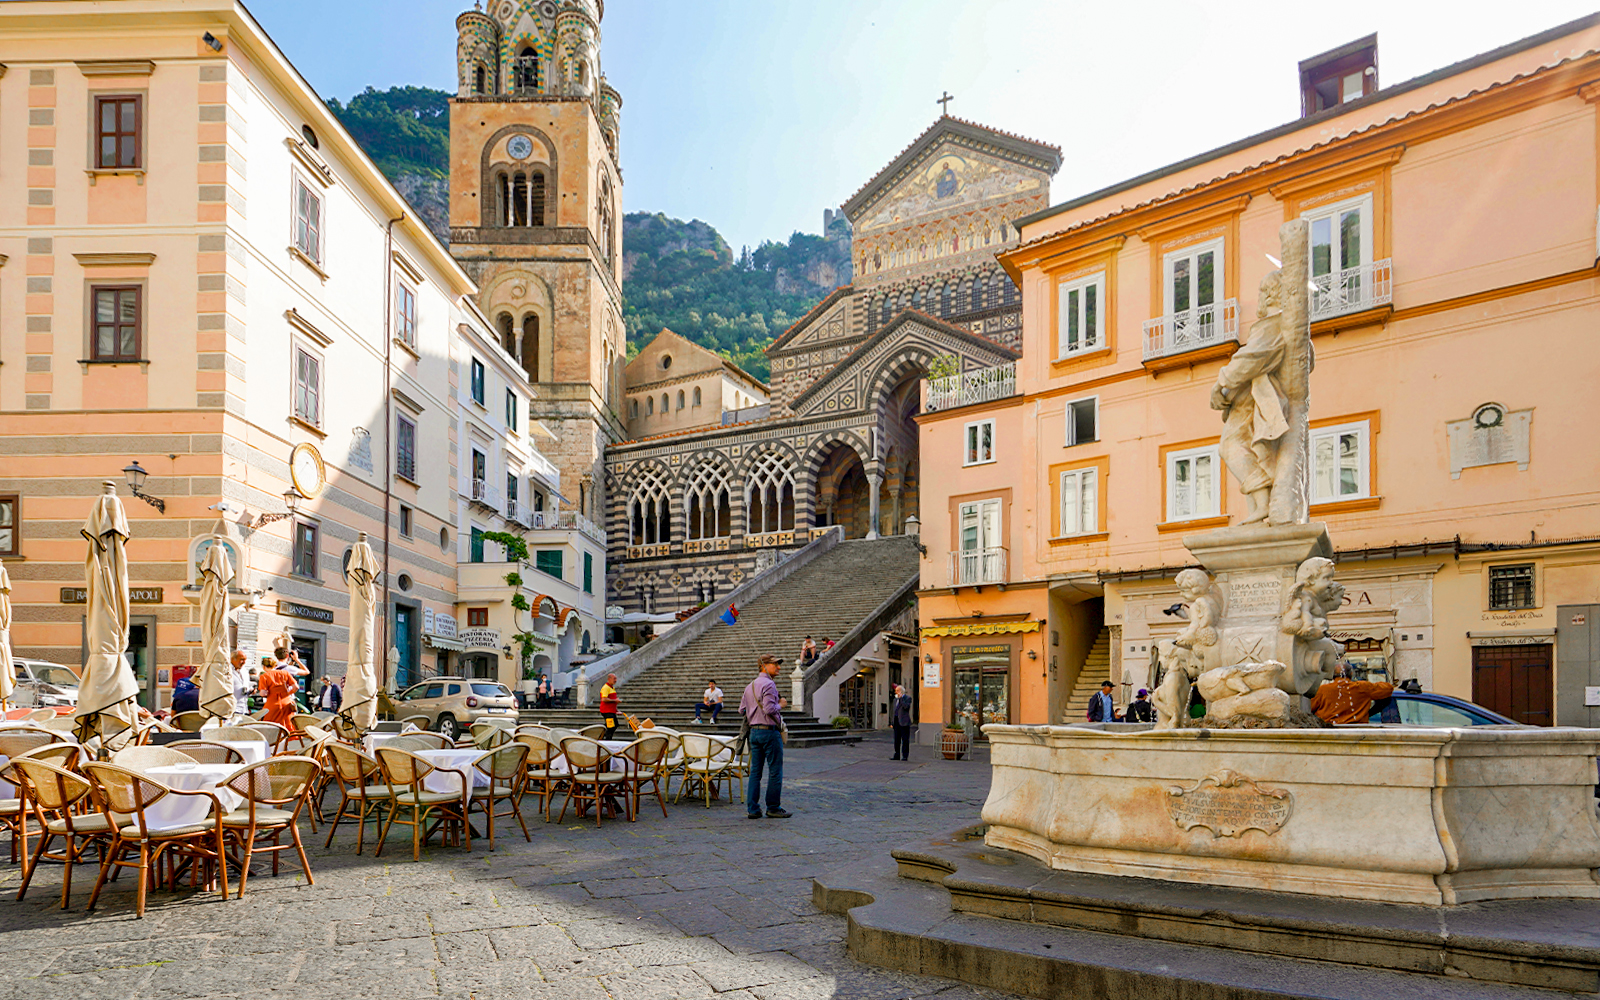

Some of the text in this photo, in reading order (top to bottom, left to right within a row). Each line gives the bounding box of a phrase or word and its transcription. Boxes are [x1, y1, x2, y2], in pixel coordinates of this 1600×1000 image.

[129, 590, 158, 600] APOLI
[289, 604, 309, 616] BANCO
[314, 610, 333, 620] NAPOLI
[459, 631, 499, 639] RISTORANTE
